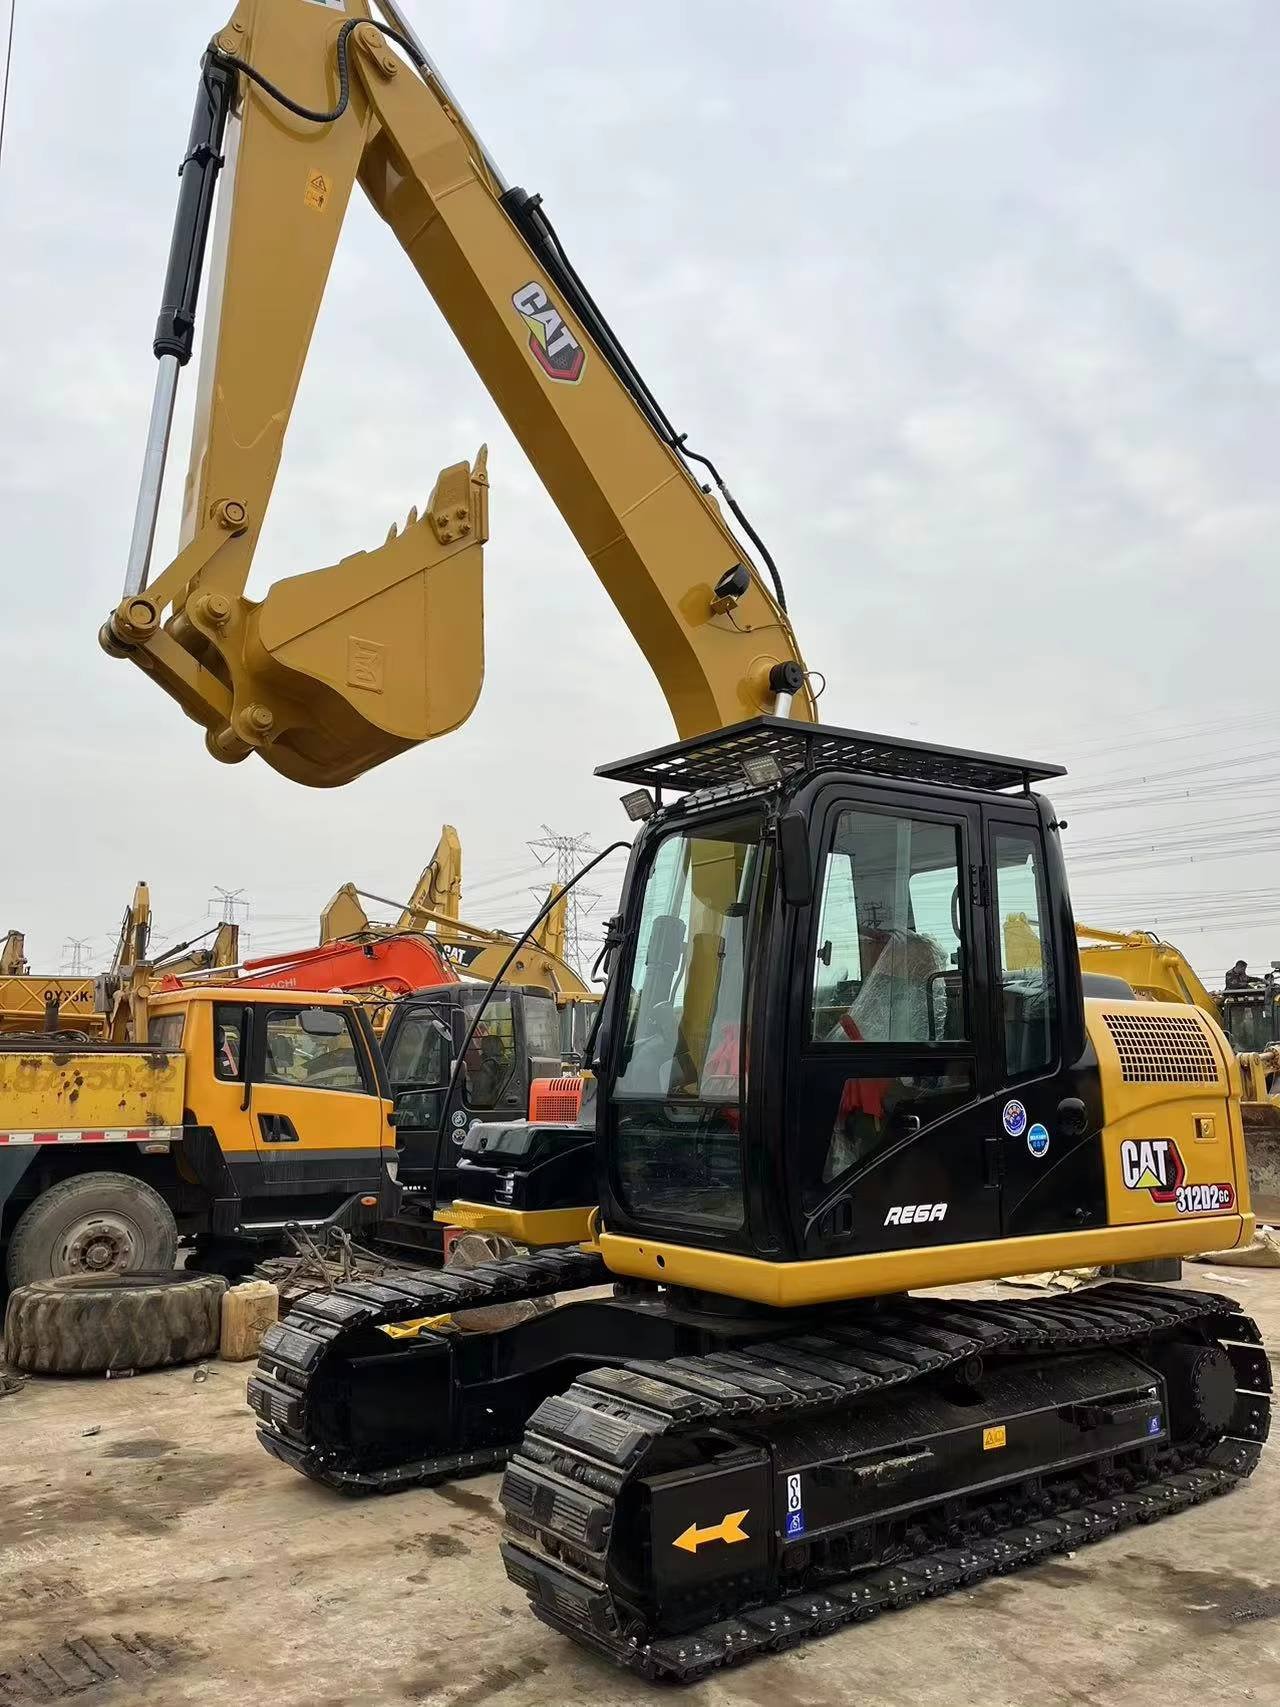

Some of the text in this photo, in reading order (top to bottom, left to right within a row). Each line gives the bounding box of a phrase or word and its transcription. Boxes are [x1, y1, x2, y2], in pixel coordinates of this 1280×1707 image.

[512, 281, 579, 357] CAT
[441, 944, 466, 965] CAT
[1121, 1140, 1168, 1188] CAT
[1176, 1185, 1219, 1211] 312D2
